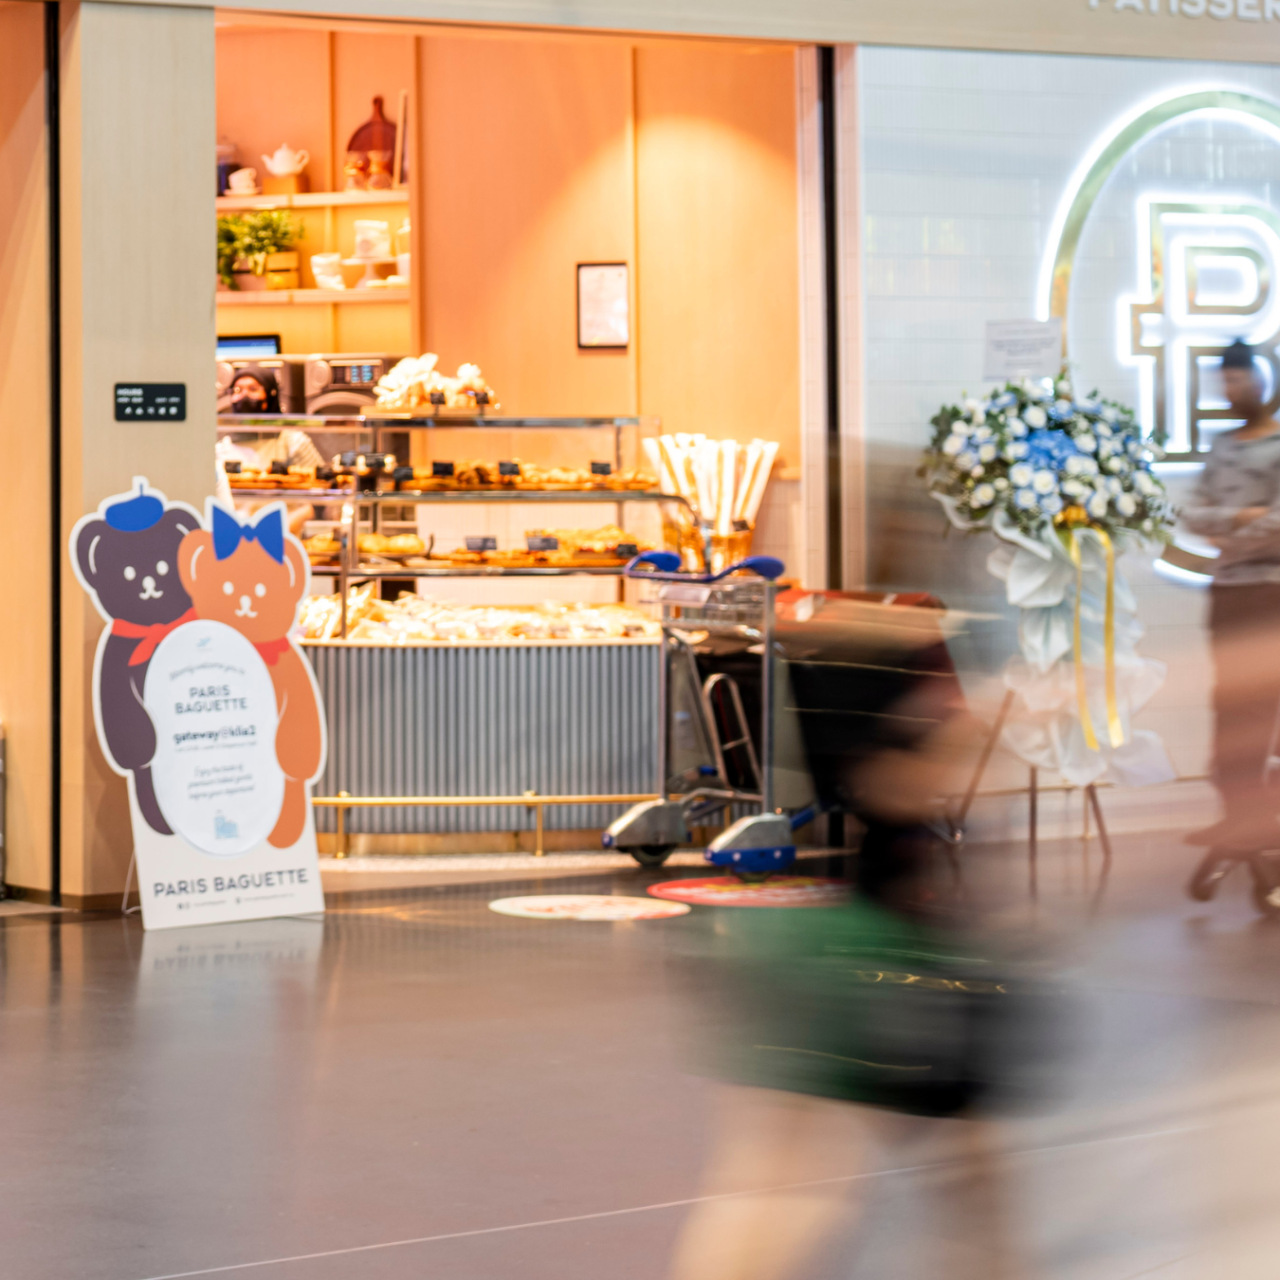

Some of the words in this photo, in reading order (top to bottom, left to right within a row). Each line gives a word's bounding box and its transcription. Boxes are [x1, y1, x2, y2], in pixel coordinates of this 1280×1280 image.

[189, 684, 231, 698] PARIS
[174, 697, 249, 714] BAGUETTE
[172, 724, 257, 745] gateway@klia2
[153, 877, 208, 898] PARIS
[213, 867, 309, 892] BAGUETTE
